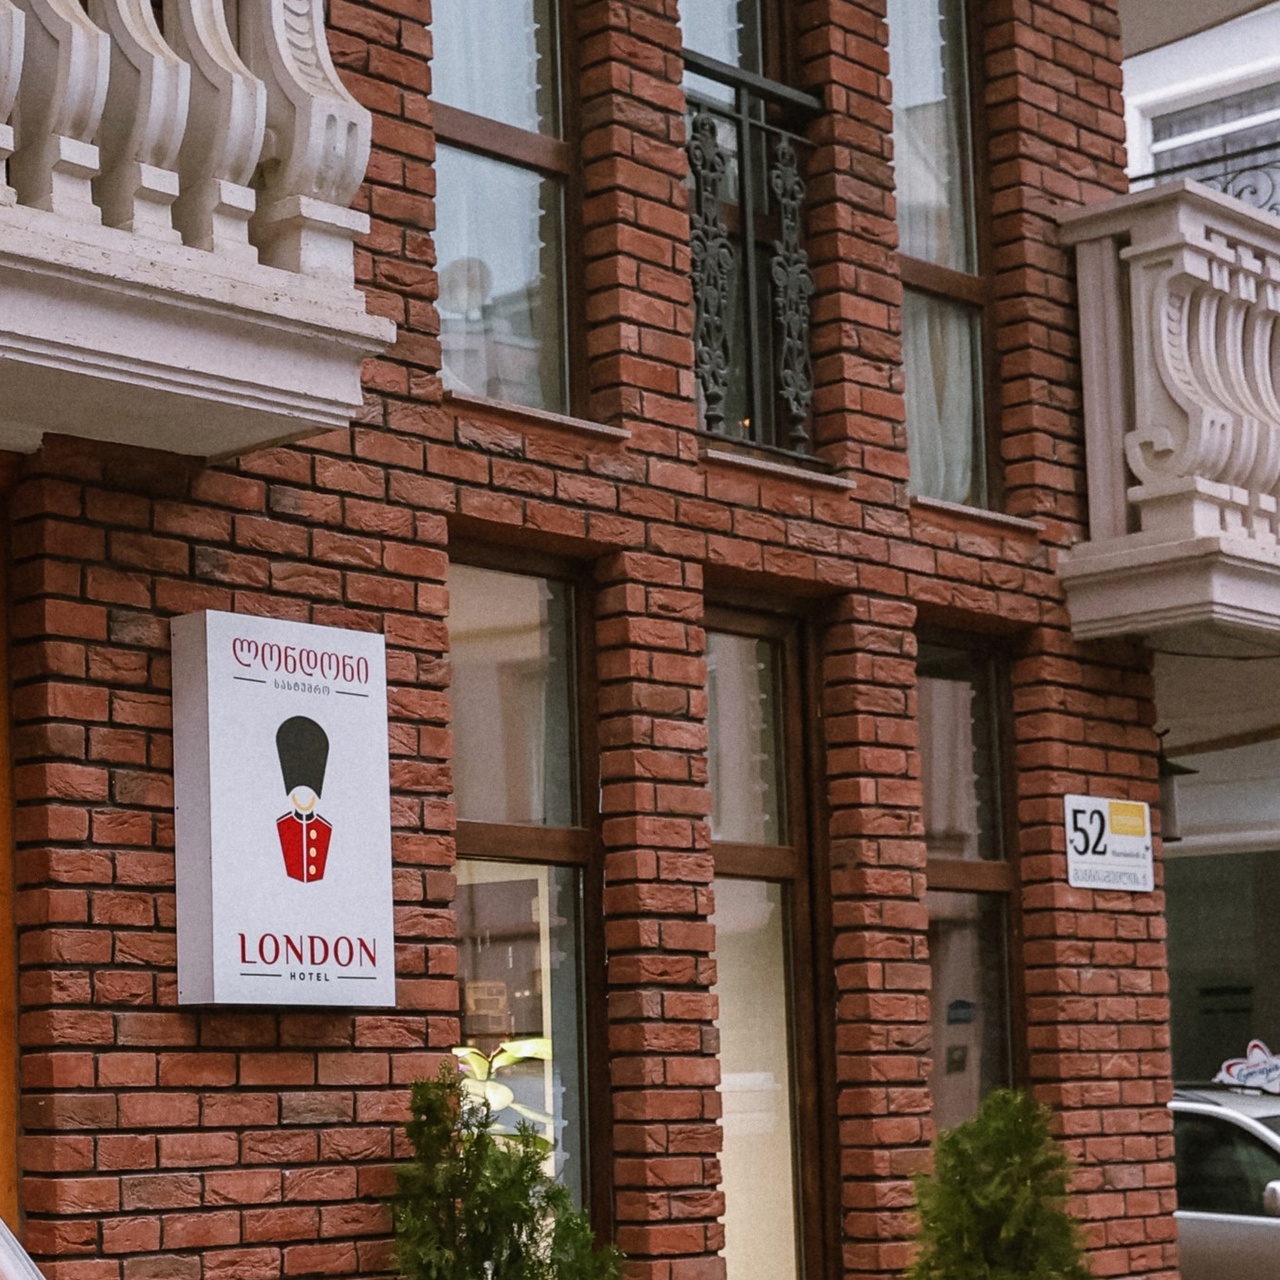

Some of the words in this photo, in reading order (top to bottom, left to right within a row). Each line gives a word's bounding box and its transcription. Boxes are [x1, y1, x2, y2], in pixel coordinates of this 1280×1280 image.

[232, 637, 370, 685] ლონდონი
[273, 678, 331, 697] სასტუმრო
[1071, 808, 1108, 856] 52
[238, 932, 377, 968] LONDON
[289, 970, 331, 983] HOTEL
